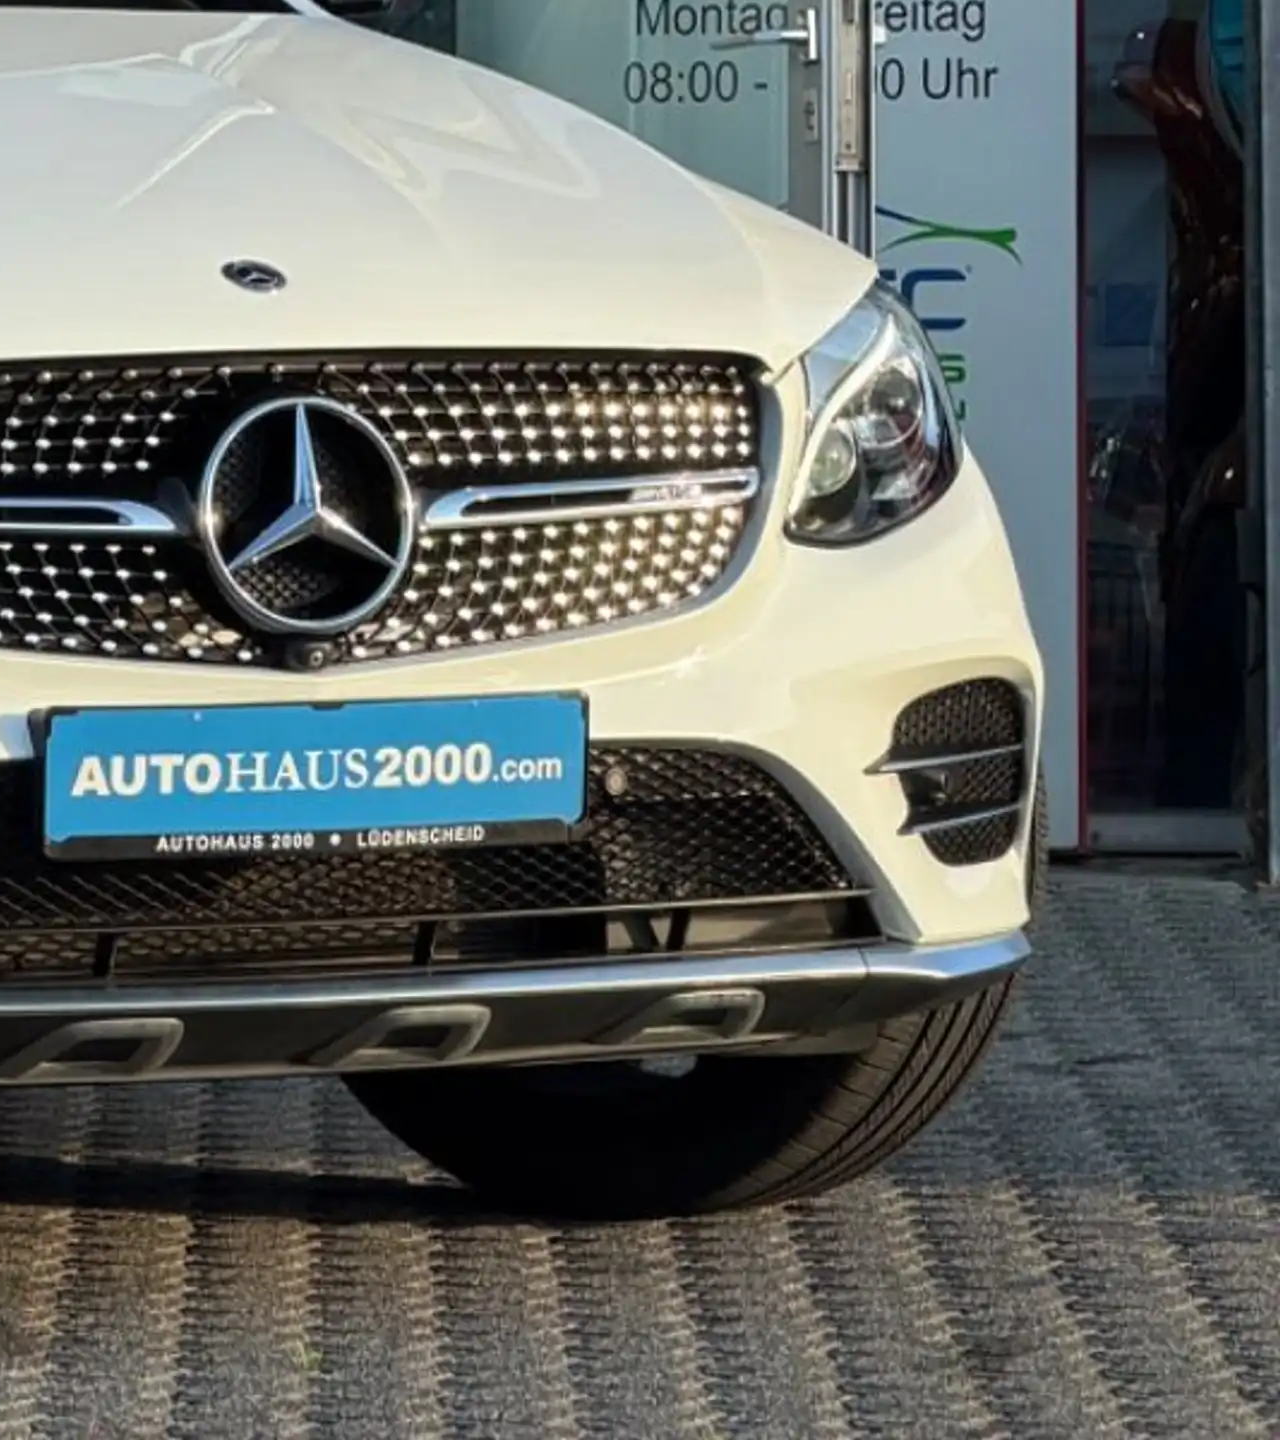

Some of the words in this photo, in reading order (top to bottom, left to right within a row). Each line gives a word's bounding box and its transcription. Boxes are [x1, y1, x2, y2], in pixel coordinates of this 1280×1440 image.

[624, 61, 738, 103] 08:00
[922, 57, 998, 99] Uhr
[71, 743, 564, 797] AUTOHAUS2000.com
[156, 834, 265, 853] AUTOHAUS
[271, 831, 315, 850] 2000
